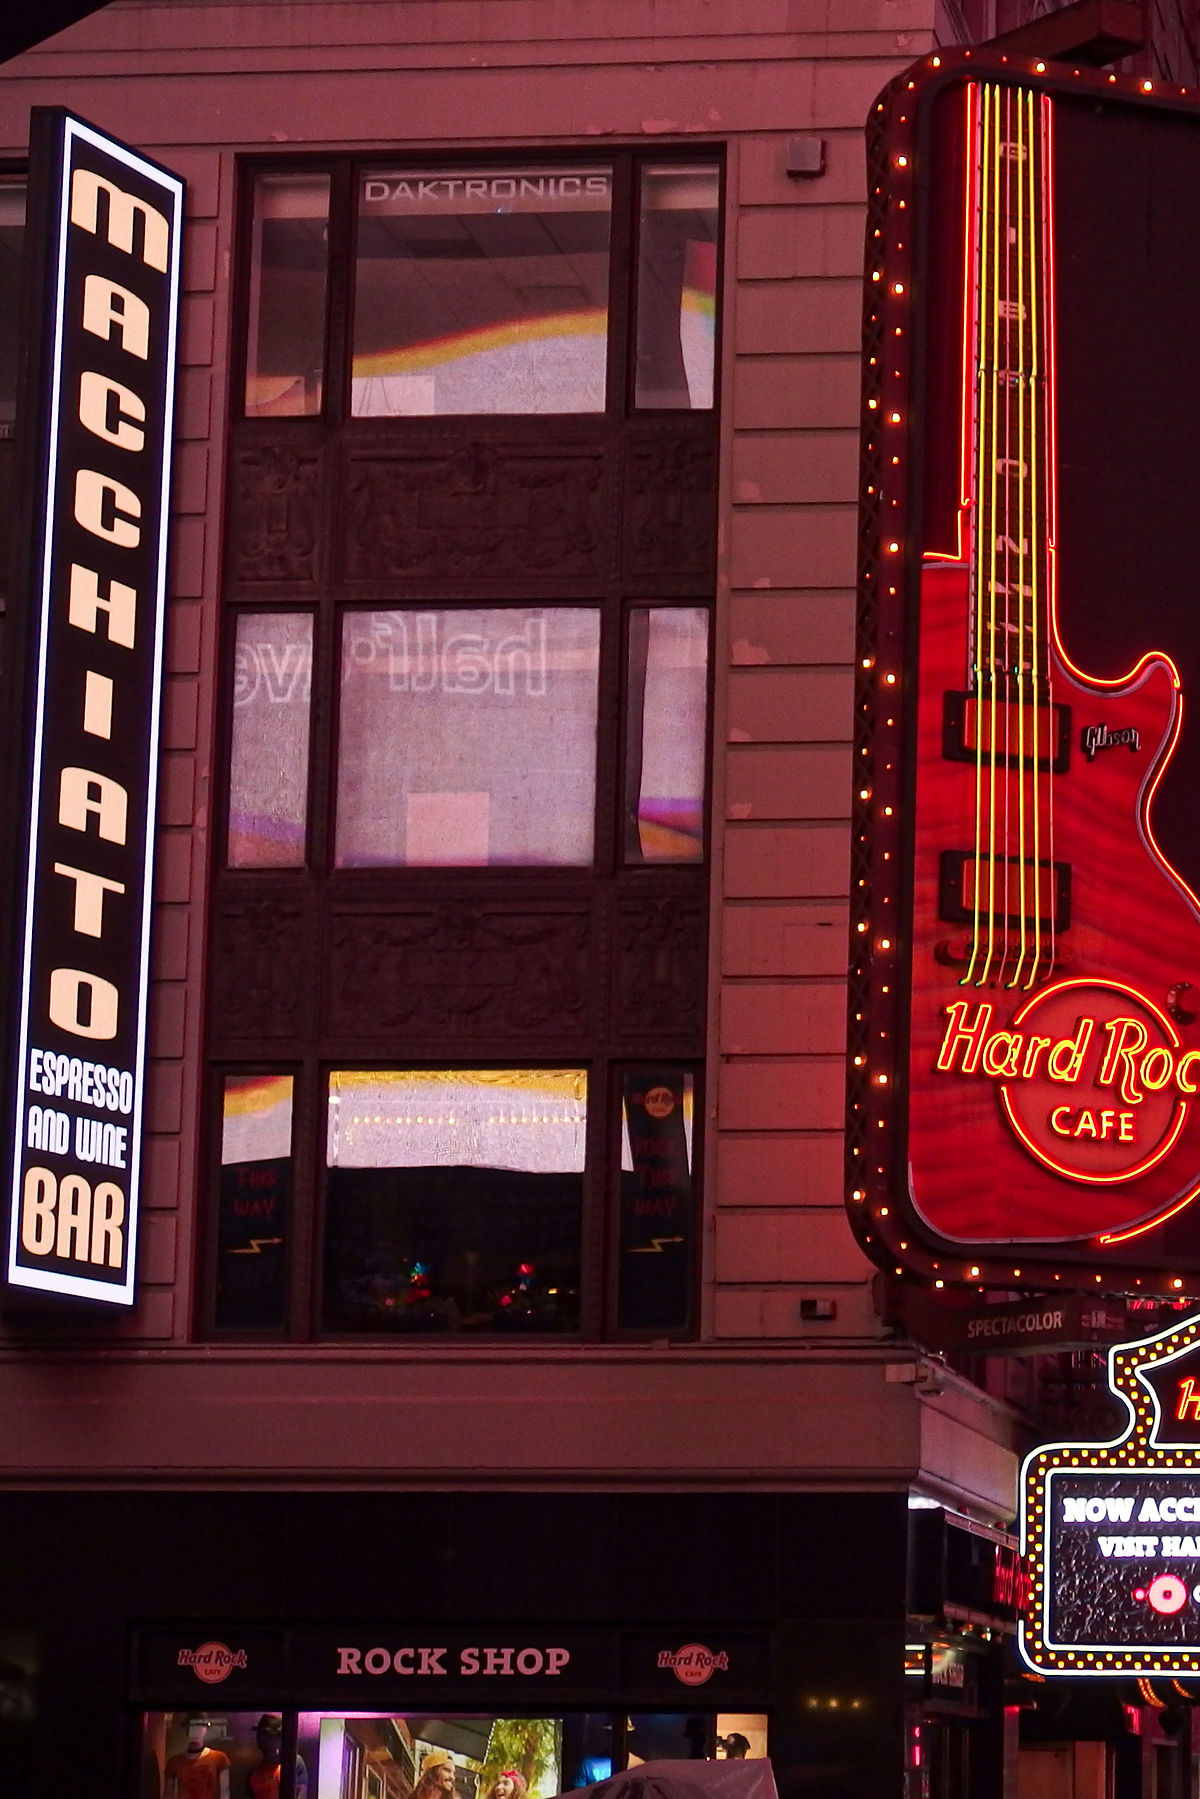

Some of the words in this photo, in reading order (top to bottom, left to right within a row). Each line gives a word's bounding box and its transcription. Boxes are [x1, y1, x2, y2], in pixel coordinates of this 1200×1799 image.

[365, 177, 608, 202] DAKTRONICS
[48, 167, 170, 1040] MACCHIATO
[937, 1001, 1094, 1082] Hard
[29, 1048, 134, 1115] ESPRESSO
[27, 1105, 71, 1156] AND
[75, 1116, 128, 1169] WINE
[1051, 1106, 1134, 1141] CAFE
[22, 1166, 125, 1269] BAR
[967, 1310, 1063, 1339] SPECTACOLOR
[1063, 1497, 1136, 1523] NOW
[1098, 1536, 1159, 1557] VISIT
[177, 1647, 213, 1666] Hard
[214, 1648, 248, 1669] Rock
[337, 1646, 448, 1676] ROCK
[460, 1646, 571, 1676] SHOP
[657, 1650, 693, 1668] Hard
[695, 1650, 729, 1671] Rock
